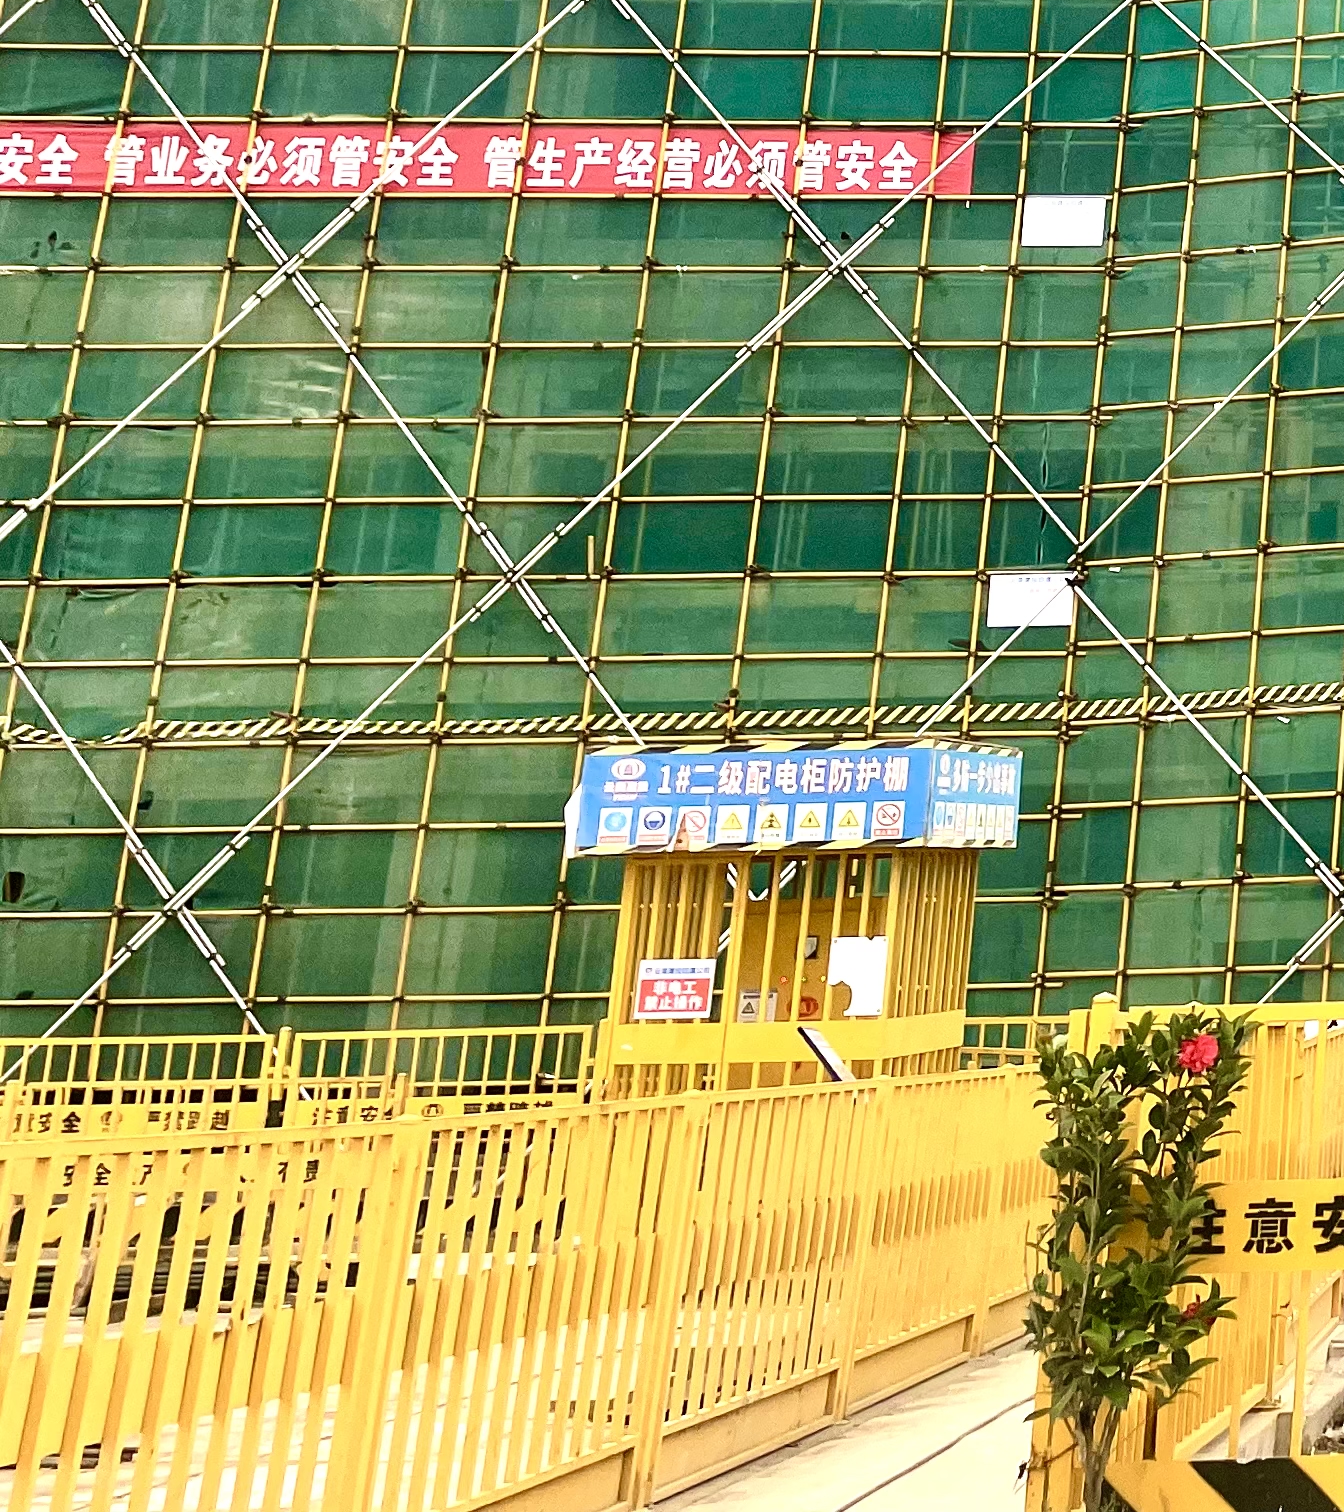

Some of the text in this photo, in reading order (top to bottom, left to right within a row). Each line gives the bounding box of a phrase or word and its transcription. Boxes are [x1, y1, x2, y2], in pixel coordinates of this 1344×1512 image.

[0, 133, 919, 191] 安全 管业务必须管安全 管生产经营必须管安全
[657, 756, 911, 796] 1#二级配电柜防护棚
